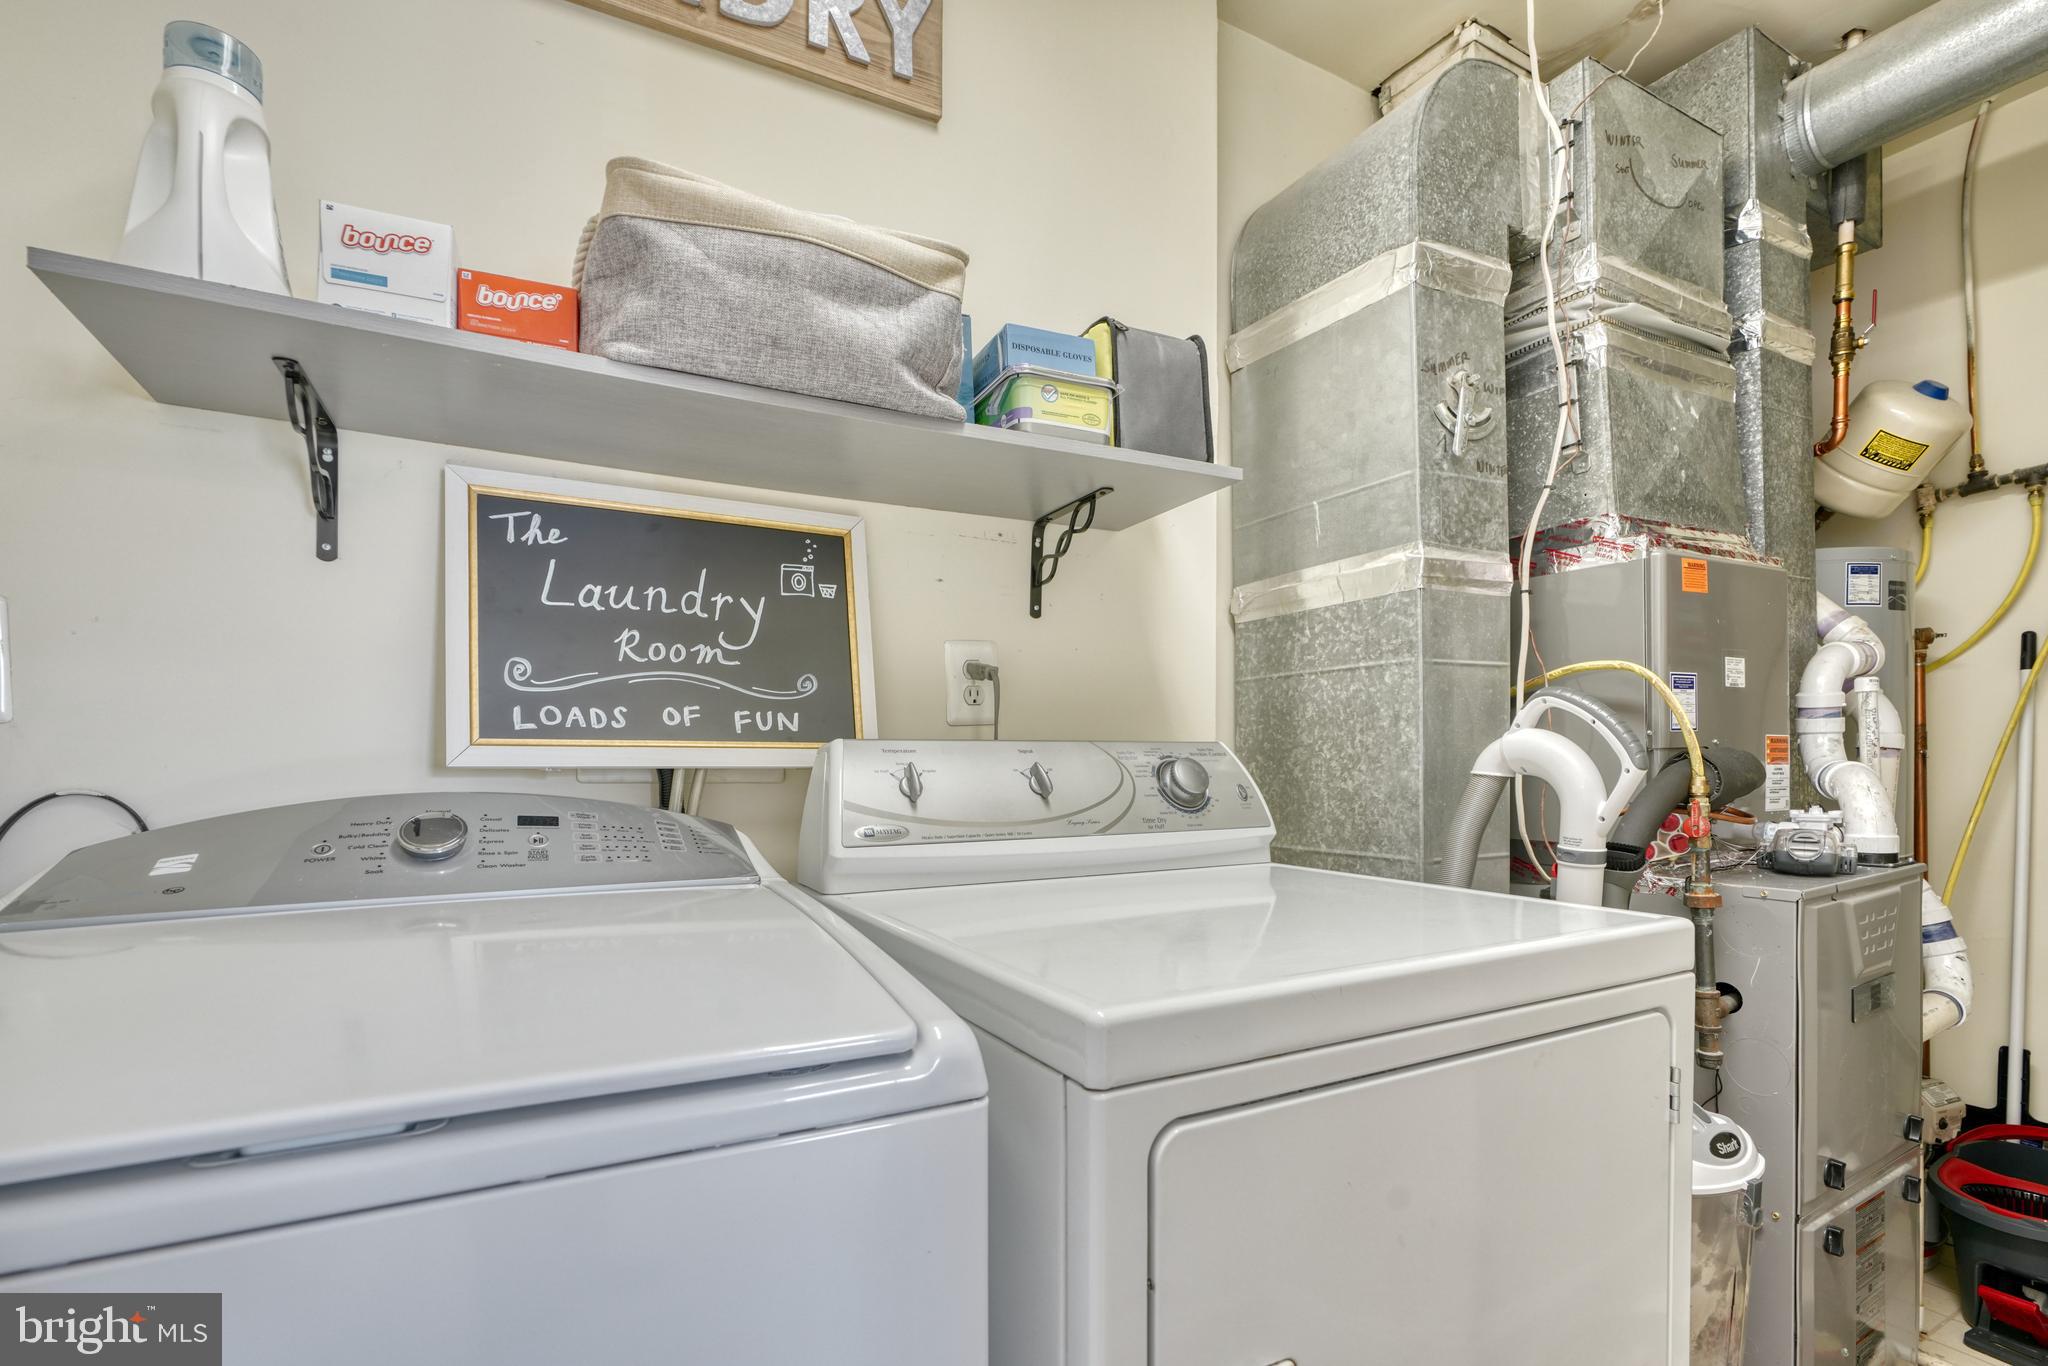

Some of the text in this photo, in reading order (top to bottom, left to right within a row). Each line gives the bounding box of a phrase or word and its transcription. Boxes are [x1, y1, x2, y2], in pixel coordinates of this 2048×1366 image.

[1605, 129, 1645, 149] WINTER
[341, 223, 433, 254] bounce
[475, 283, 560, 312] bounce
[1011, 341, 1092, 363] DISPOSABLE GLOVES
[488, 511, 568, 546] The
[540, 558, 765, 650] Laundry
[513, 705, 800, 734] LOADS OF FUN
[875, 828, 902, 836] MAYTAG
[1716, 1138, 1740, 1155] Shark
